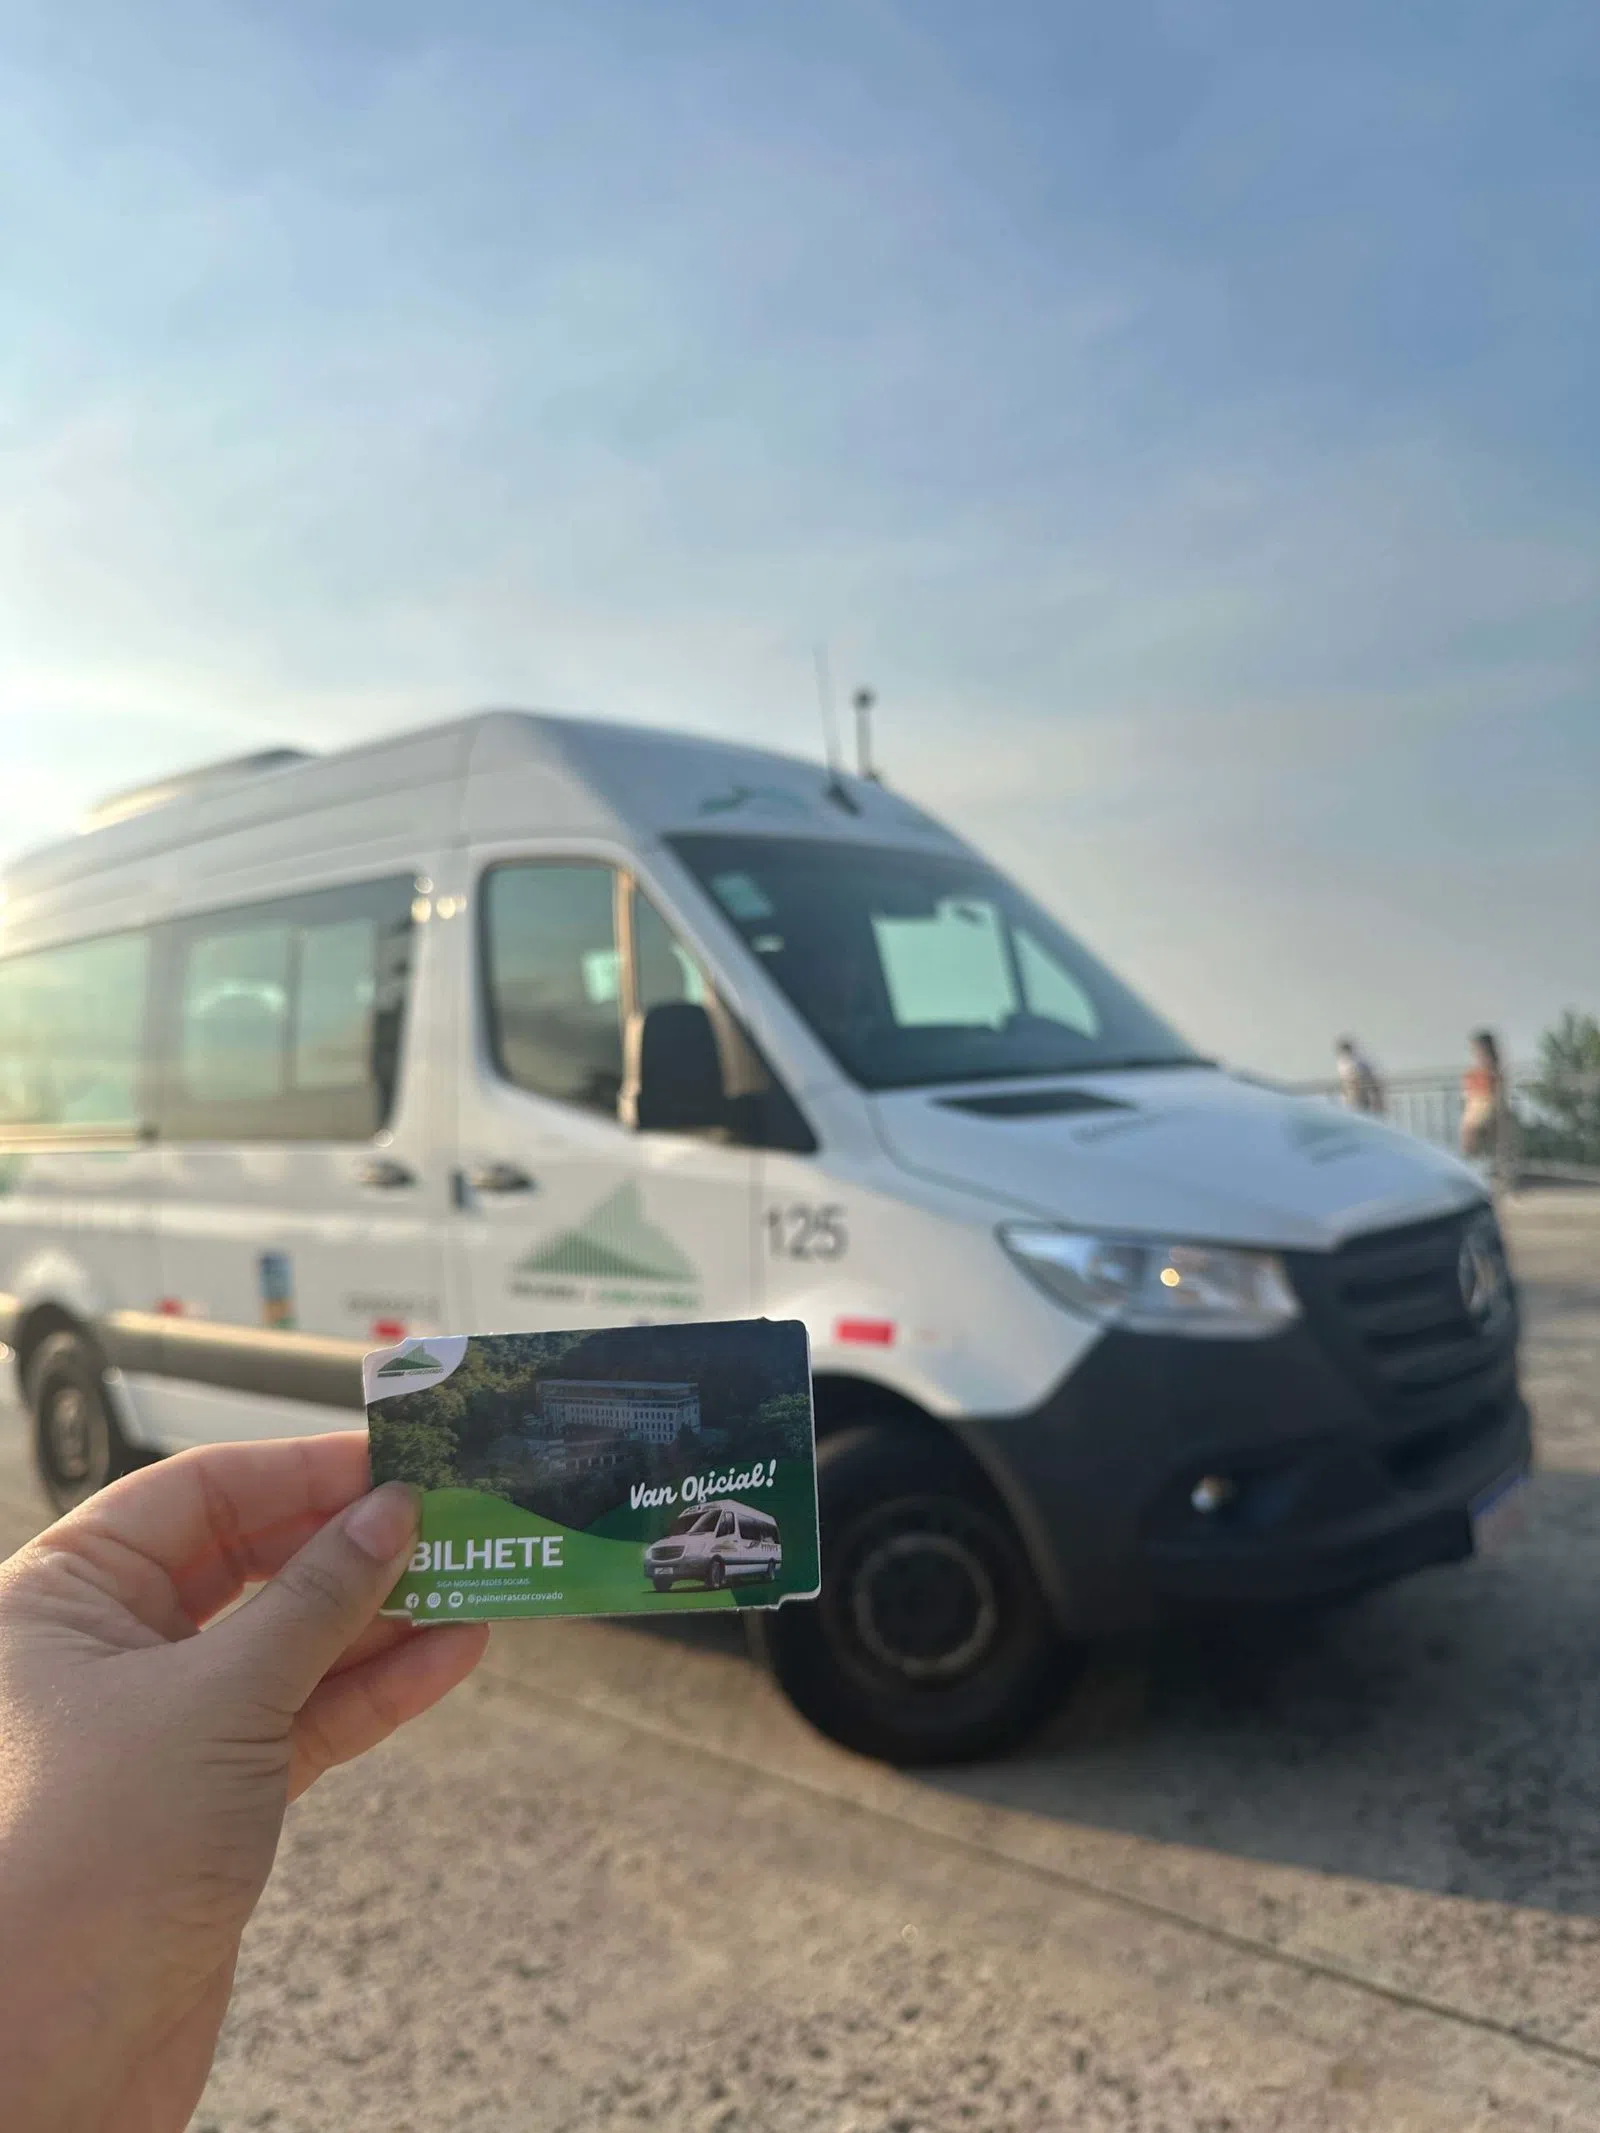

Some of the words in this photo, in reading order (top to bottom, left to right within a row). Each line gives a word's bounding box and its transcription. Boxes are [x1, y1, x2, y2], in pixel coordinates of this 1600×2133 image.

[763, 1202, 848, 1261] 125
[630, 1482, 678, 1510] Van
[681, 1459, 777, 1504] Oficial!
[408, 1536, 564, 1573] BILHETE
[467, 1591, 564, 1605] @paineirascorcovado
